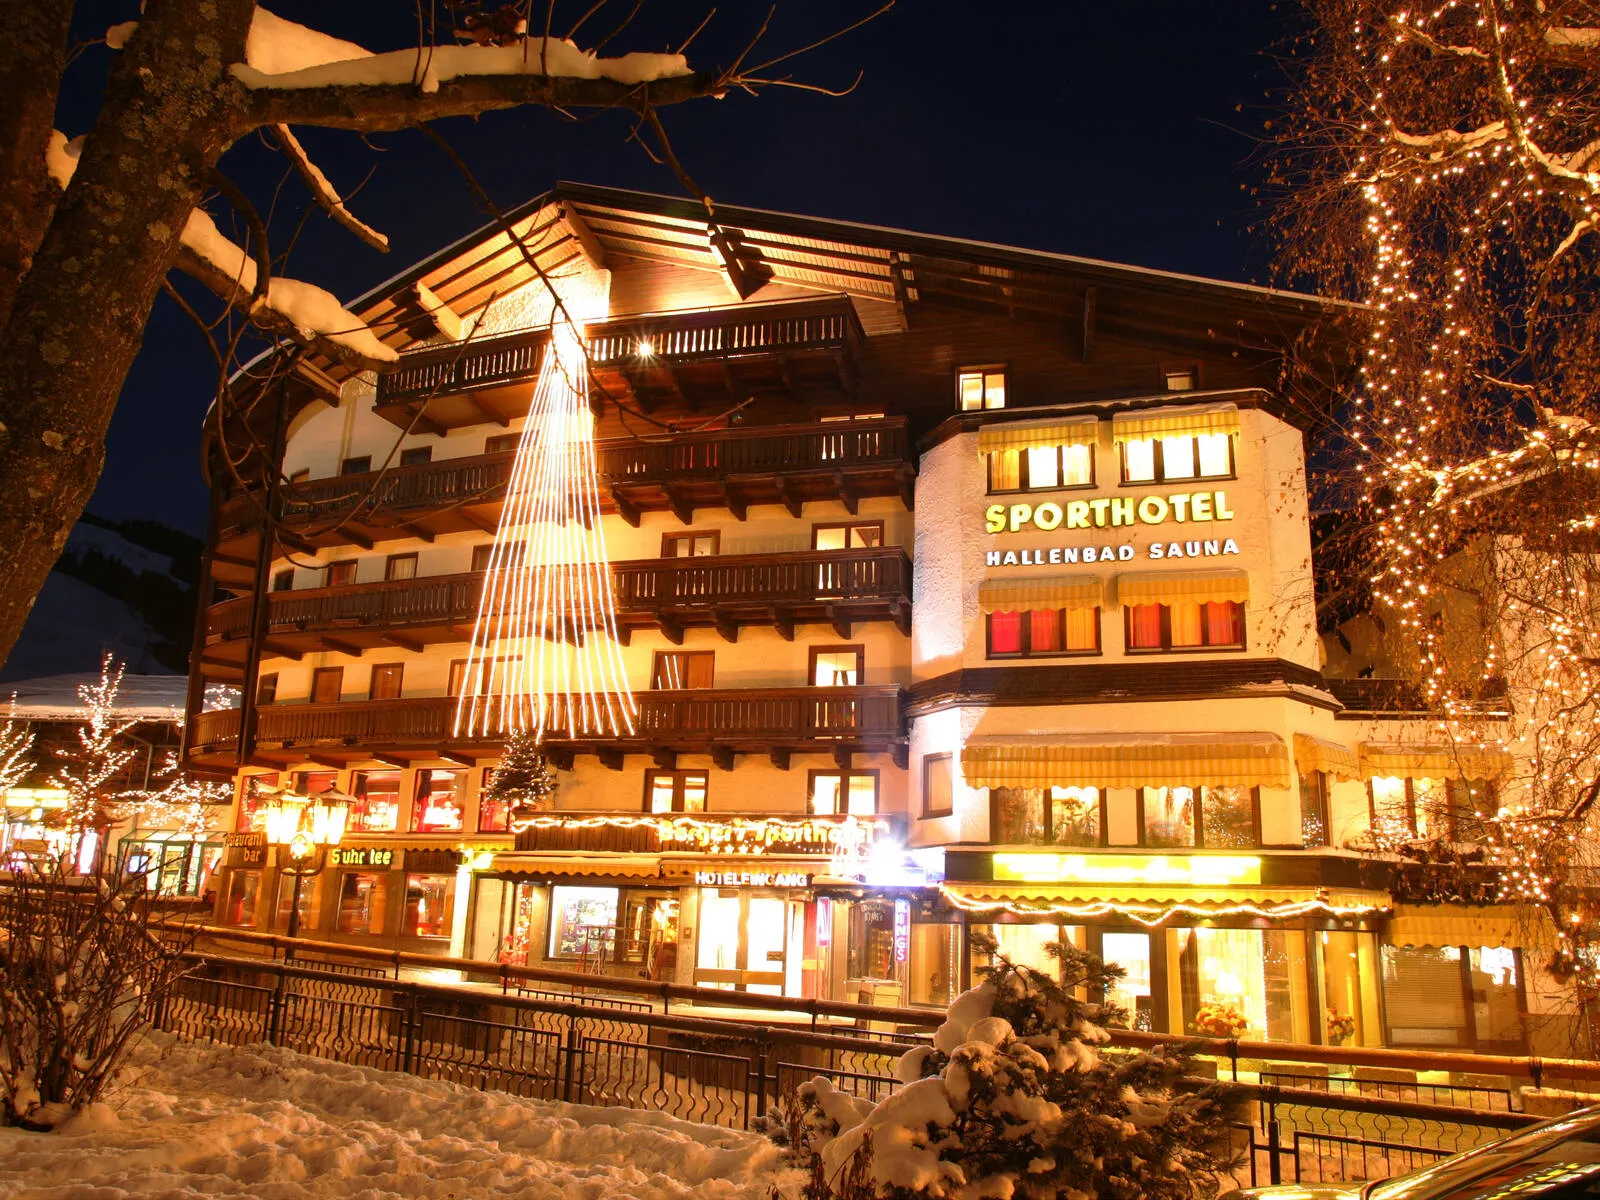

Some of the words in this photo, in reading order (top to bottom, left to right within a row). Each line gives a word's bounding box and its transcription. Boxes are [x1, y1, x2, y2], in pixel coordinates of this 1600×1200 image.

[985, 490, 1235, 534] SPORTHOTEL
[986, 545, 1135, 567] HALLENBAD
[1149, 538, 1240, 560] SAUNA
[243, 847, 261, 862] bar
[341, 849, 366, 865] uhr
[369, 848, 392, 865] tee
[896, 899, 909, 961] KINGS
